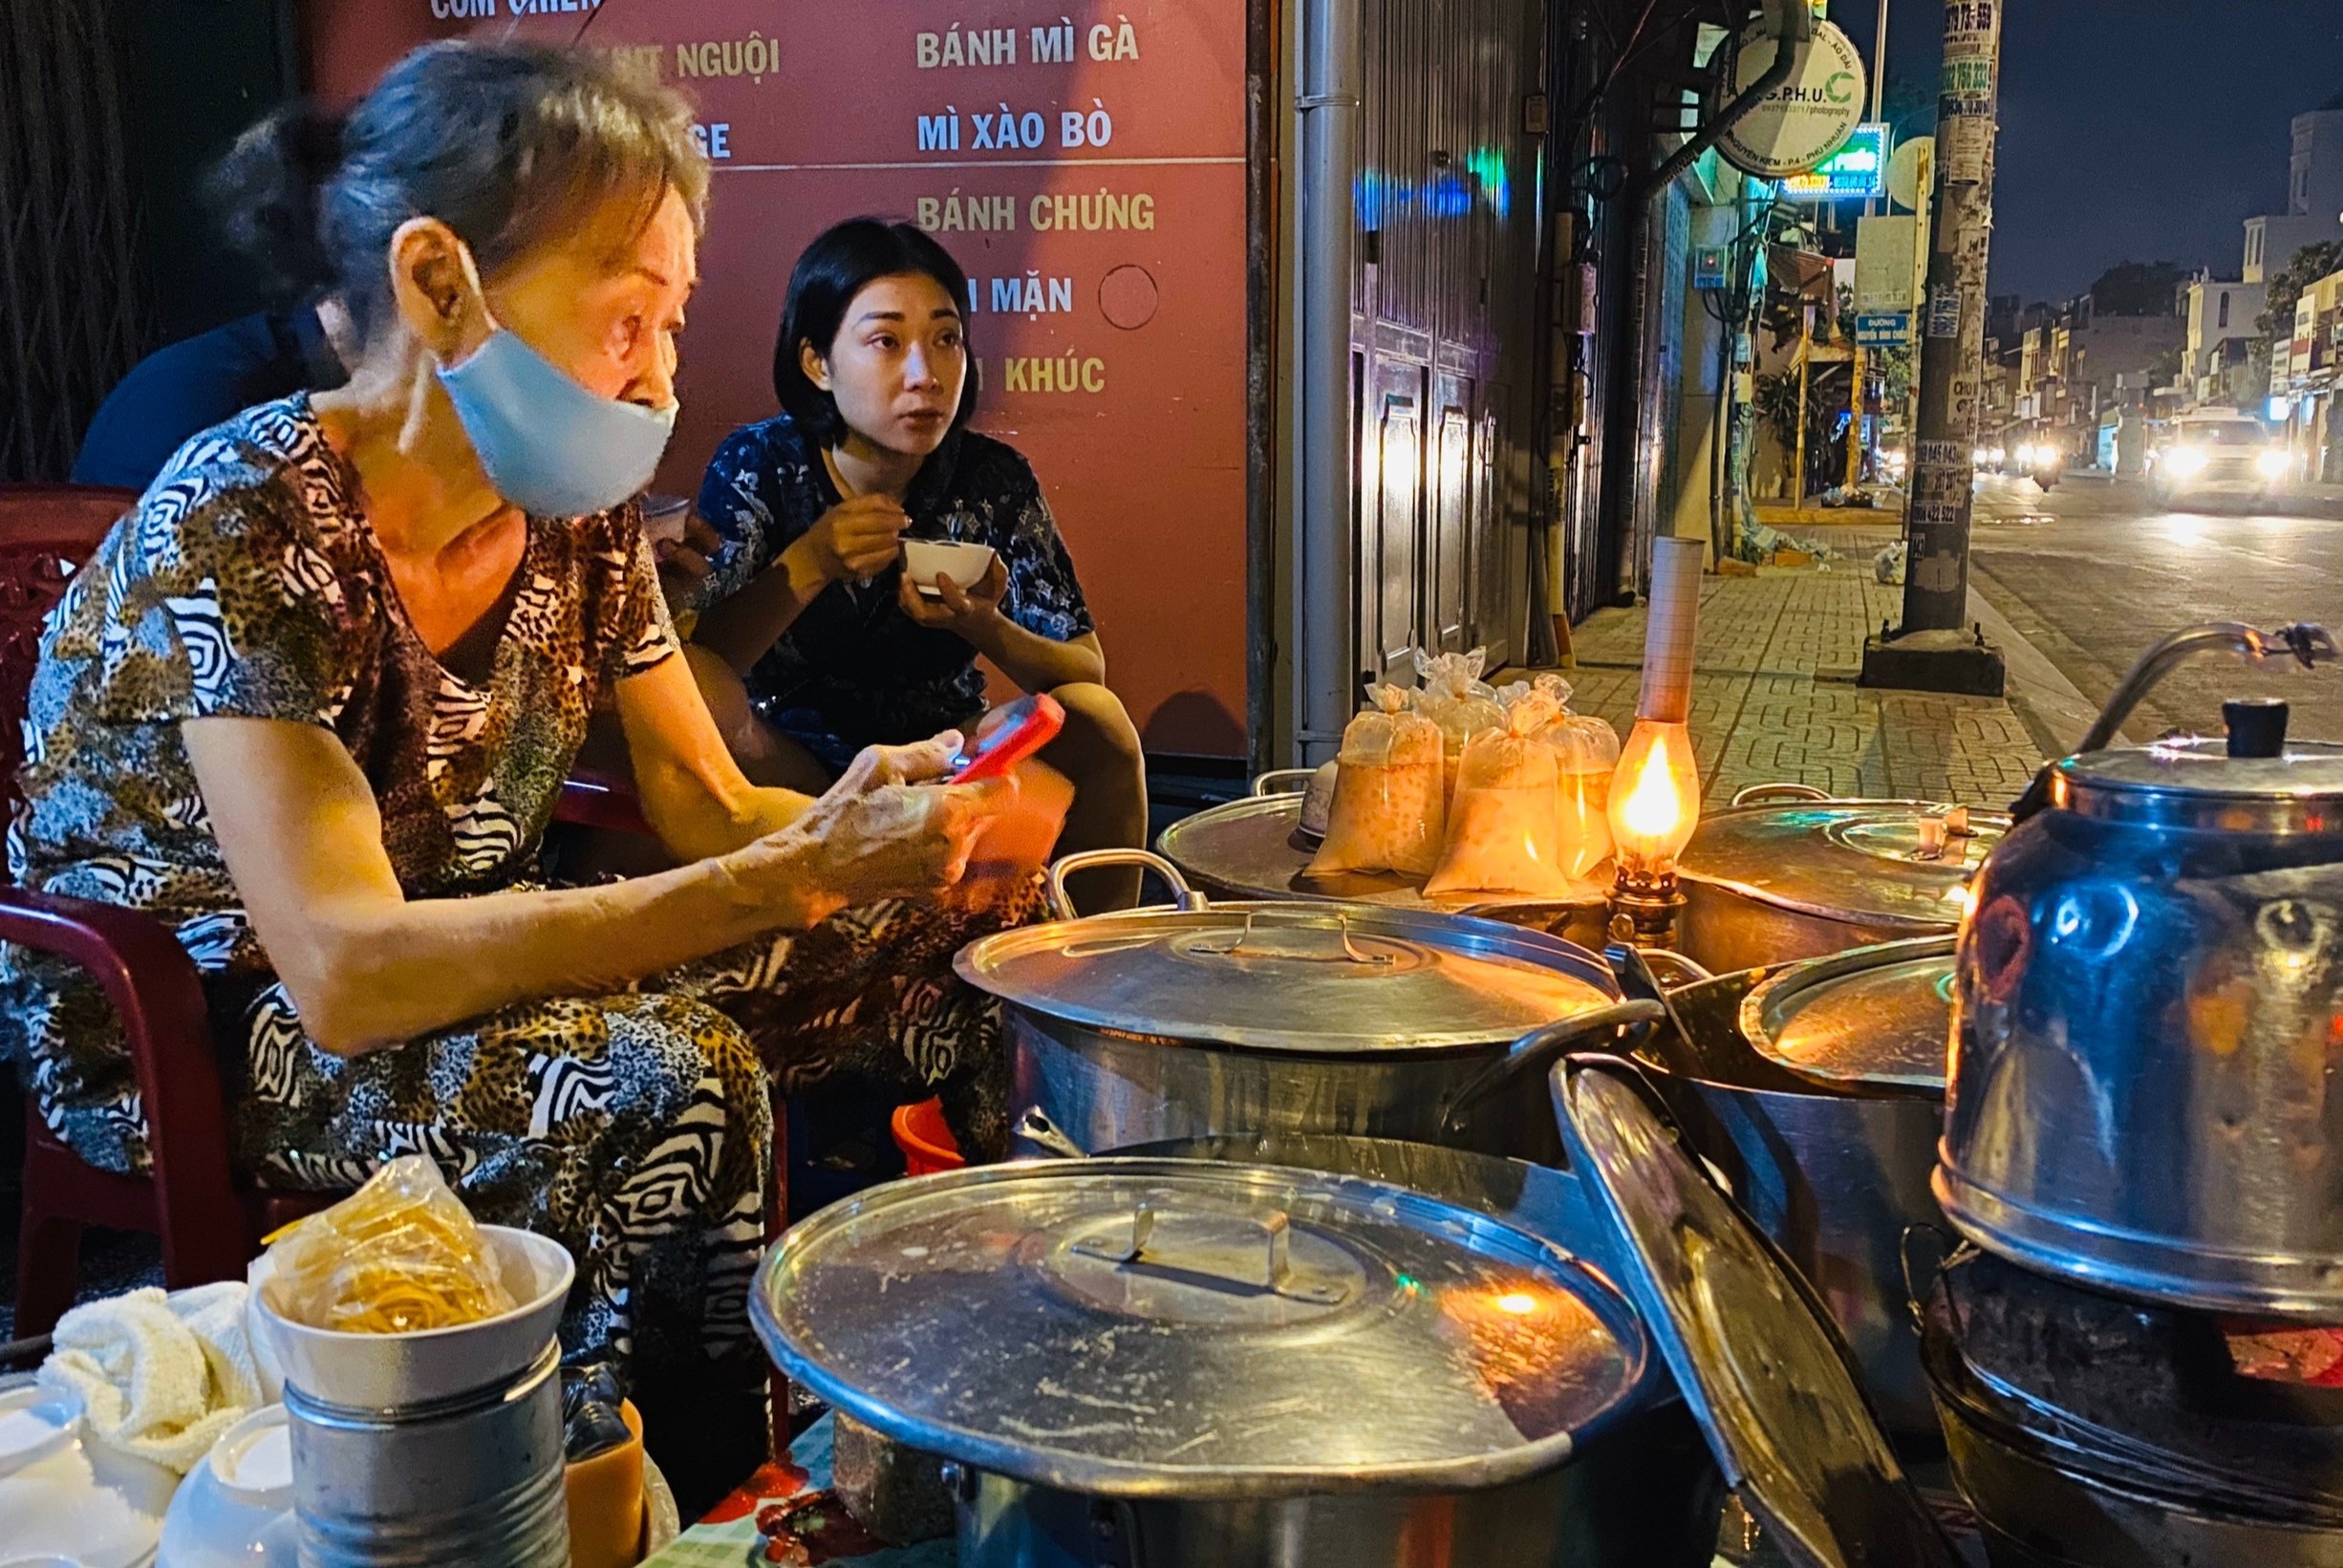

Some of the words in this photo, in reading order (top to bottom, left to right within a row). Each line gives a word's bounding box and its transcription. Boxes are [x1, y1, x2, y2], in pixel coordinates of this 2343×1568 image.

[677, 31, 780, 85] NGUỘI
[916, 22, 1016, 68] BÁNH
[1031, 16, 1074, 64] MÌ
[1087, 14, 1140, 62] GÀ
[917, 105, 959, 151] MÌ
[971, 102, 1045, 150] XÀO
[1061, 97, 1112, 148] BÒ
[916, 187, 1016, 232] BÁNH
[1029, 187, 1154, 231] CHƯNG
[991, 269, 1072, 322] MẶN
[1004, 347, 1105, 393] KHÚC
